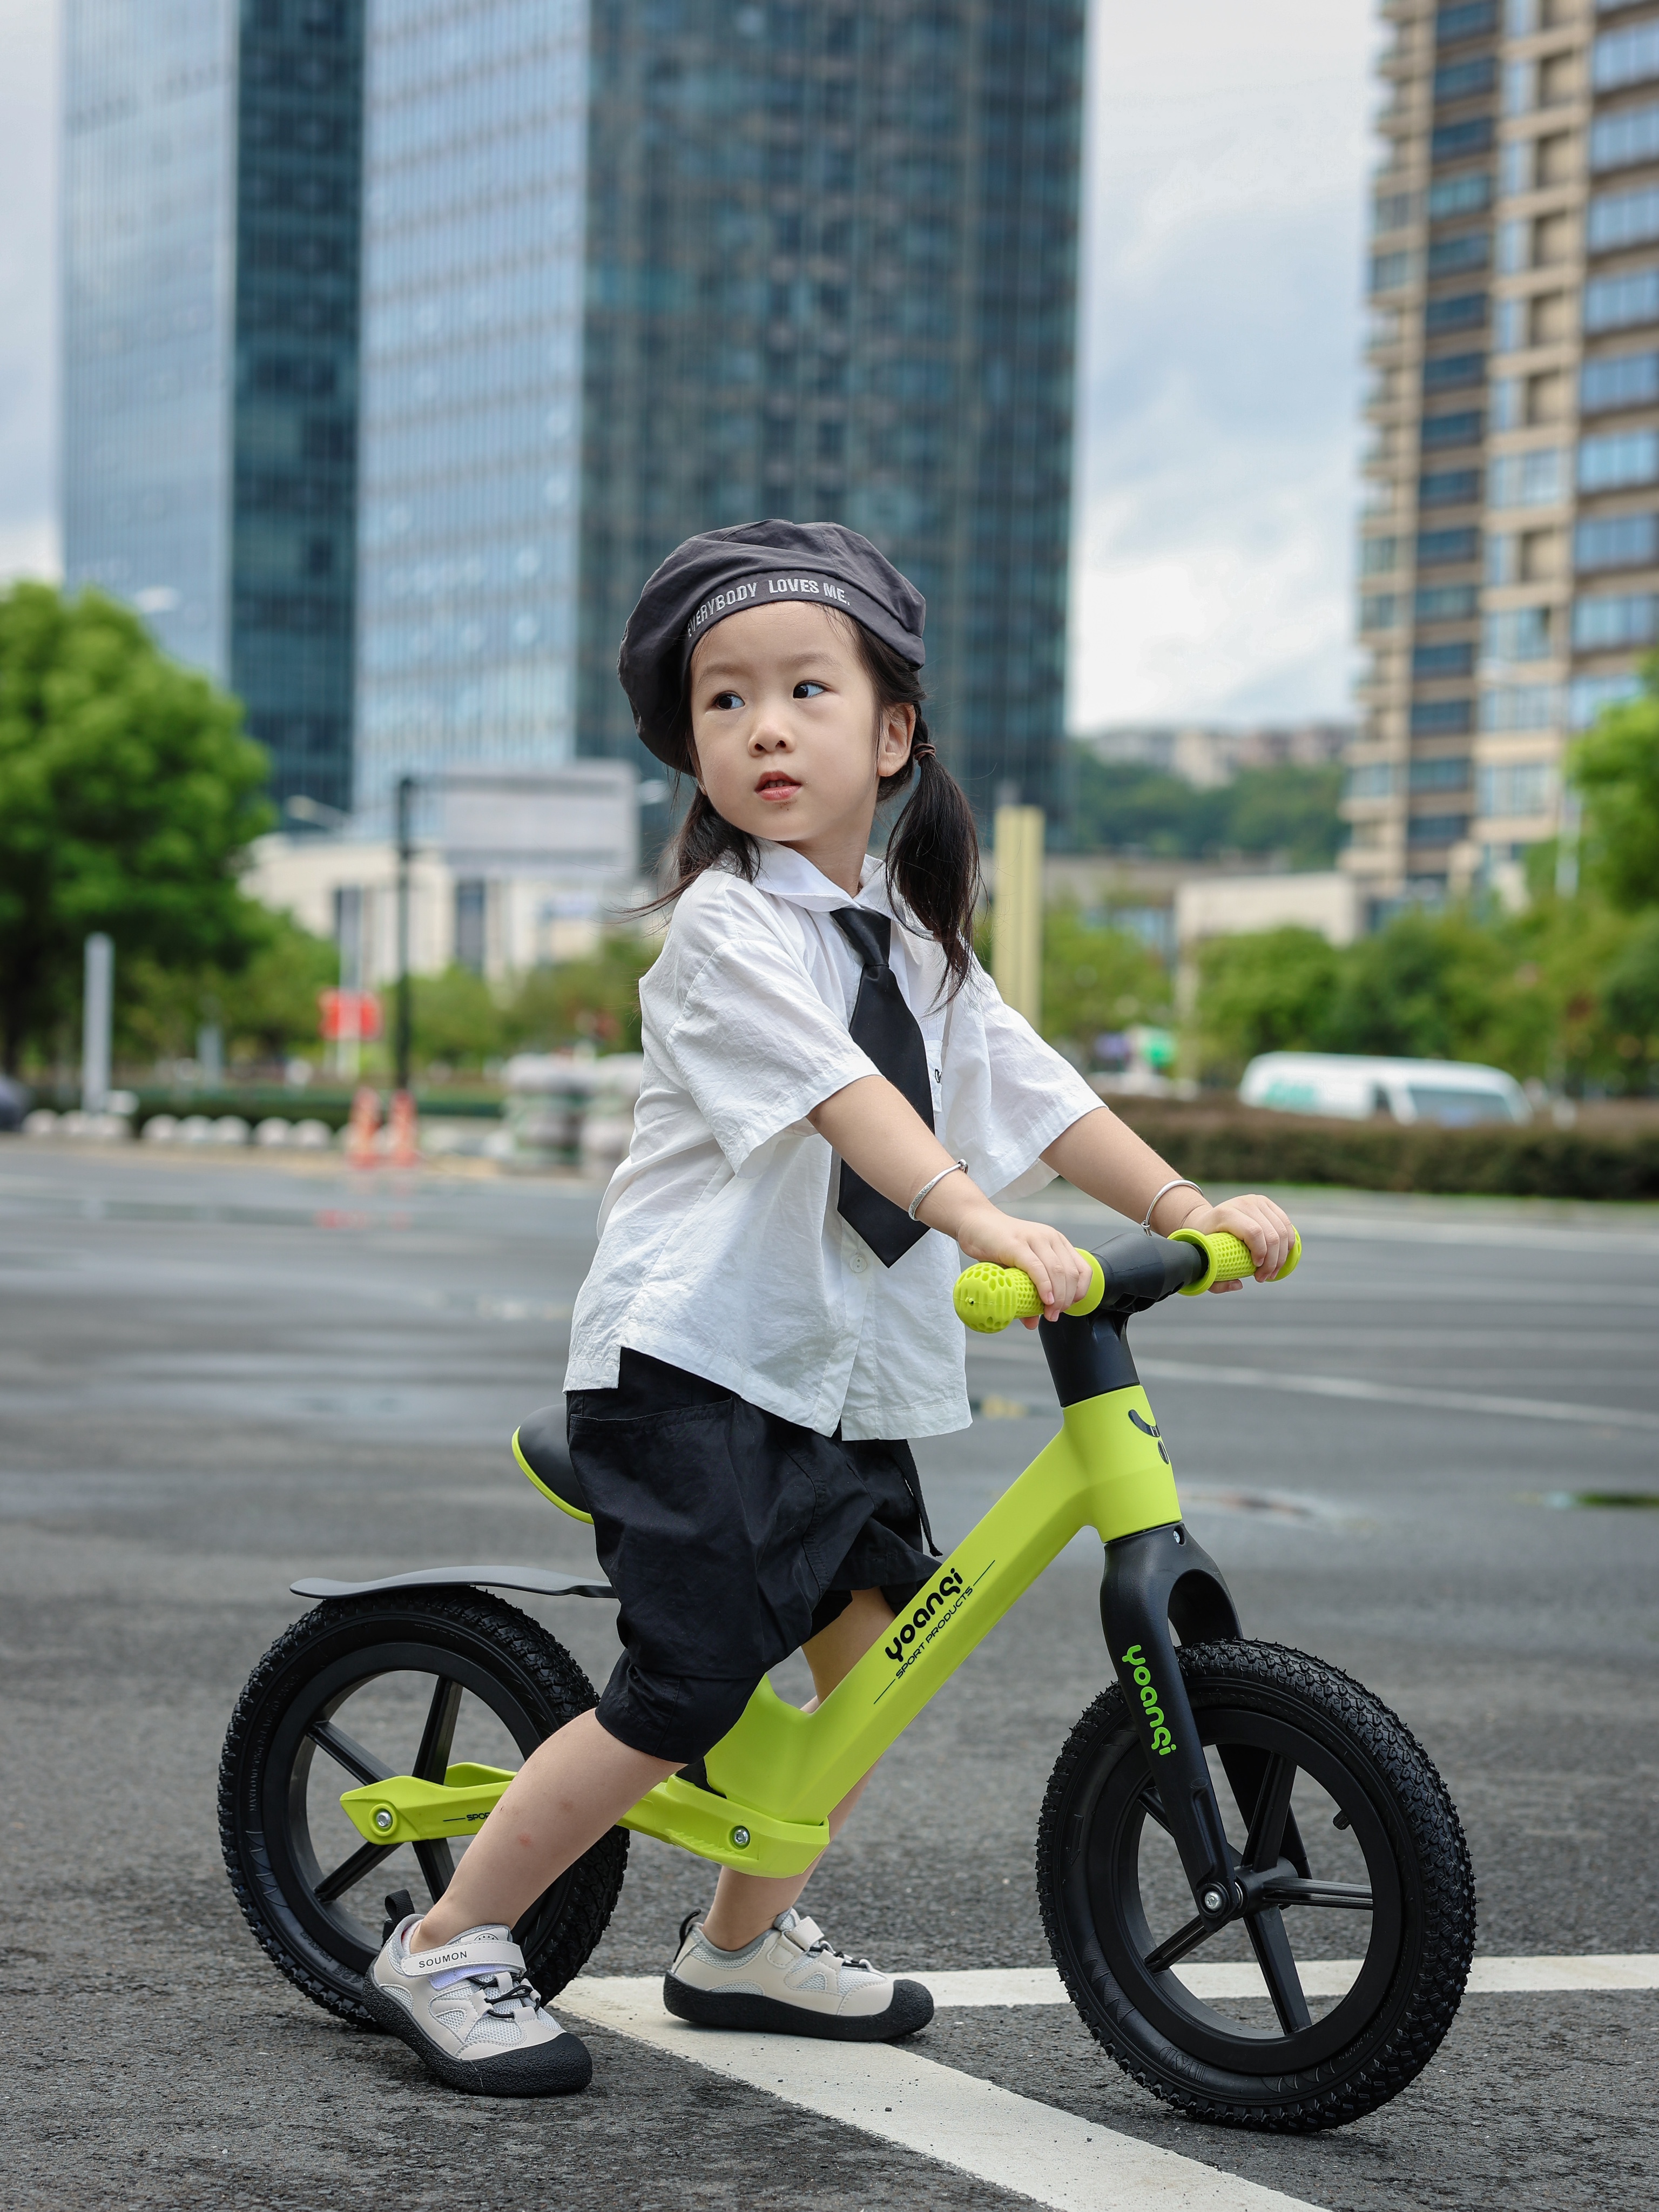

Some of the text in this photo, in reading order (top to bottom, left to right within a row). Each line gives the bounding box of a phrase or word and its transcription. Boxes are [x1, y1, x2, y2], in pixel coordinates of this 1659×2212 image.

[687, 582, 757, 638] EVERYBODY
[768, 578, 820, 594] LOVES
[895, 1586, 973, 1680] SPORT PRODUCTS
[419, 1950, 468, 1968] SOUMON
